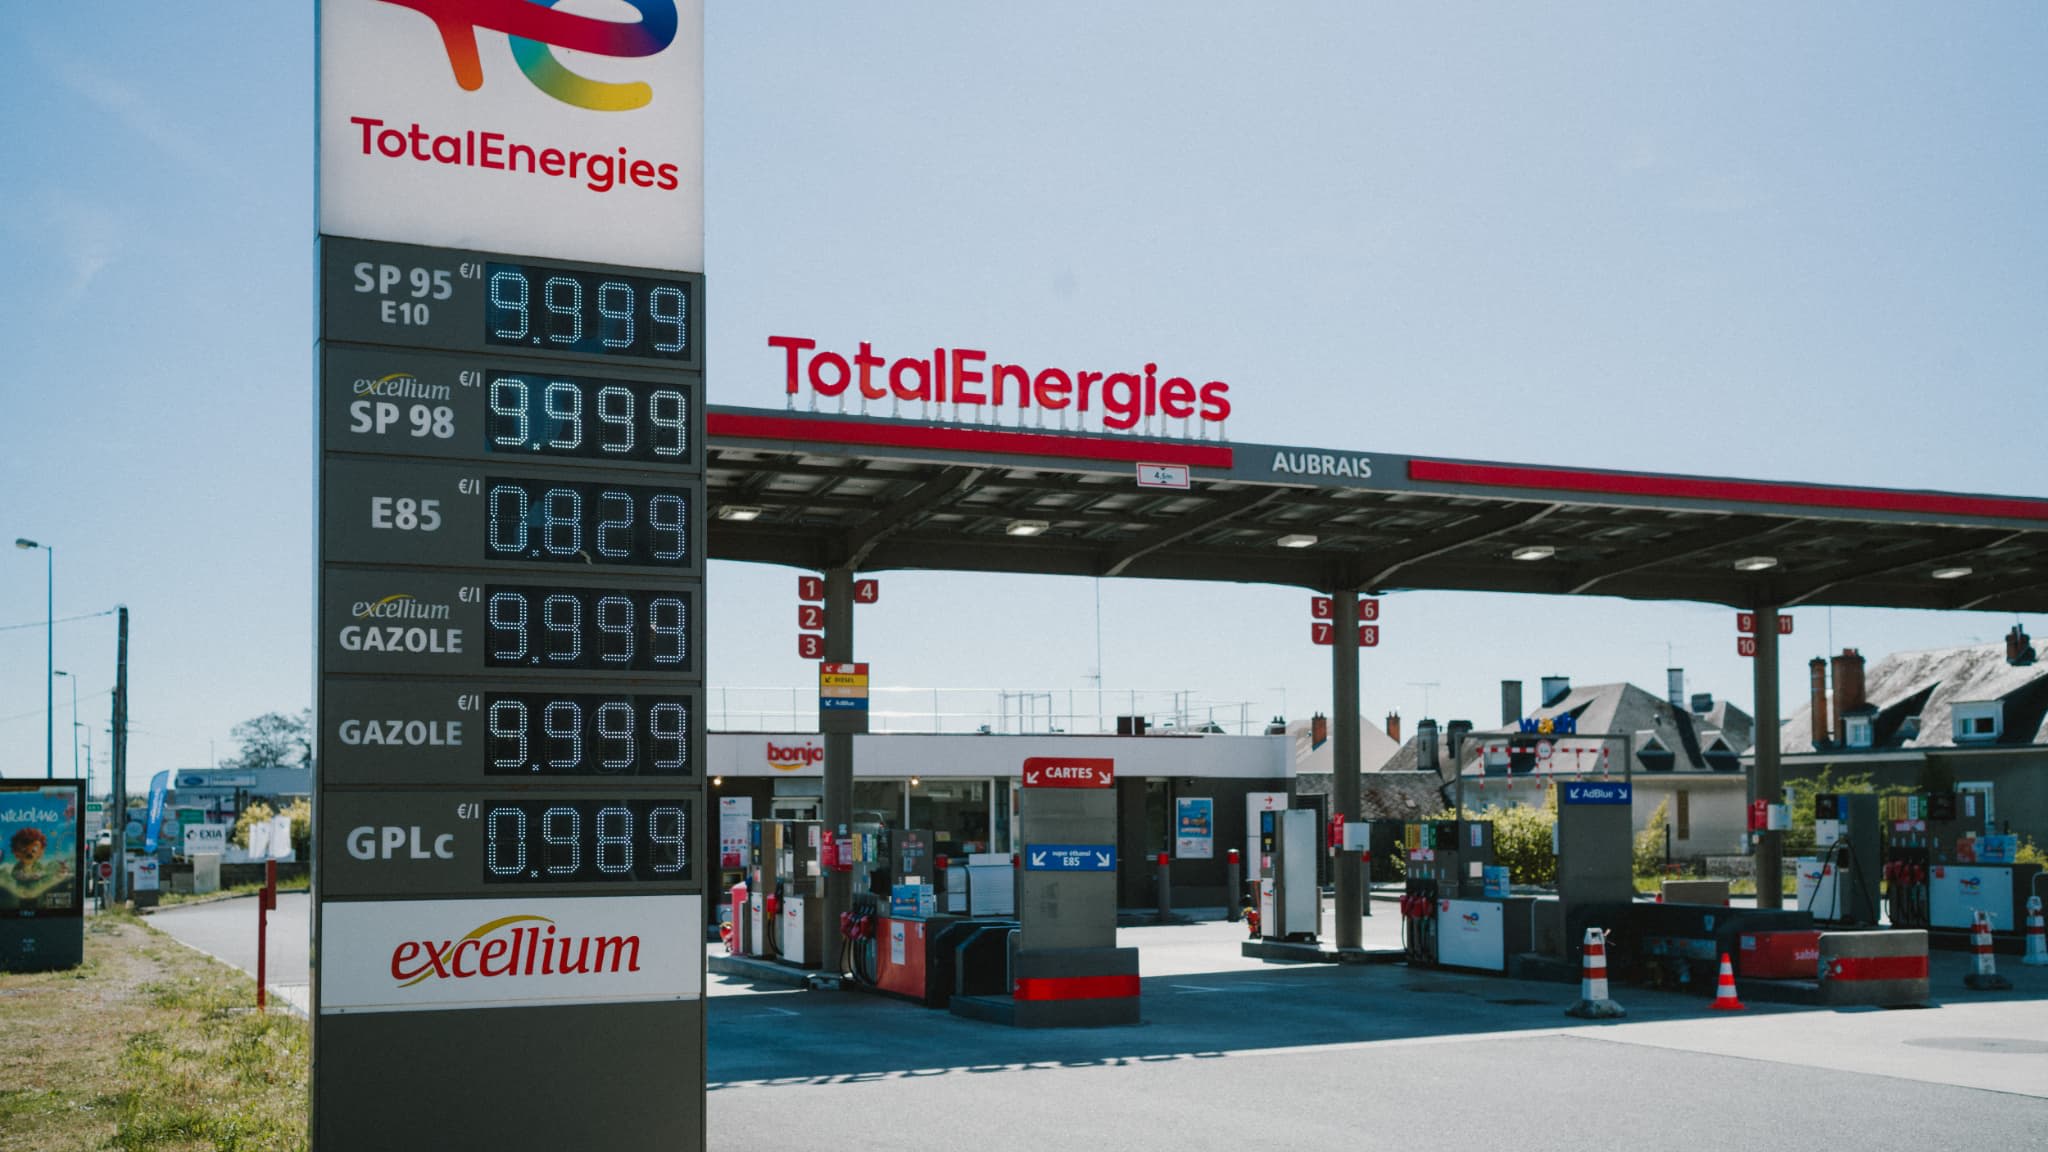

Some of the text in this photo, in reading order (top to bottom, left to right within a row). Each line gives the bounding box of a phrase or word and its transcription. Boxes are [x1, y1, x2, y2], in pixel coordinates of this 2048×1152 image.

[350, 115, 680, 193] TotalEnergies
[353, 262, 453, 300] SP 95
[380, 301, 430, 326] E10
[491, 271, 686, 352] 9.999
[353, 375, 451, 401] excellium
[768, 335, 1231, 430] TotalEnergies
[350, 401, 455, 439] SP 98
[490, 378, 686, 456] 9.999
[1272, 452, 1372, 479] AUBRAIS
[371, 496, 442, 532] E85
[490, 484, 685, 560] 0.829
[806, 580, 816, 598] 1
[861, 582, 873, 600] 4
[352, 596, 450, 621] excellium
[805, 609, 817, 626] 2
[1318, 600, 1328, 616] 5
[1364, 601, 1375, 618] 6
[490, 592, 686, 665] 9.999
[1318, 625, 1328, 642] 7
[1743, 615, 1751, 631] 9
[1780, 616, 1791, 632] 11
[339, 626, 463, 653] GAZOLE
[805, 638, 817, 656] 3
[1364, 627, 1375, 645] 8
[1740, 639, 1756, 655] 10
[338, 720, 463, 746] GAZOLE
[1517, 710, 1577, 734] wash
[490, 700, 686, 772] 9.999
[1045, 767, 1093, 778] CARTES
[1582, 788, 1613, 798] AdBlue
[200, 831, 222, 840] EXIA
[346, 826, 455, 860] GPLc
[489, 807, 686, 878] 0.989
[1063, 857, 1080, 867] E85
[390, 923, 641, 982] excellium
